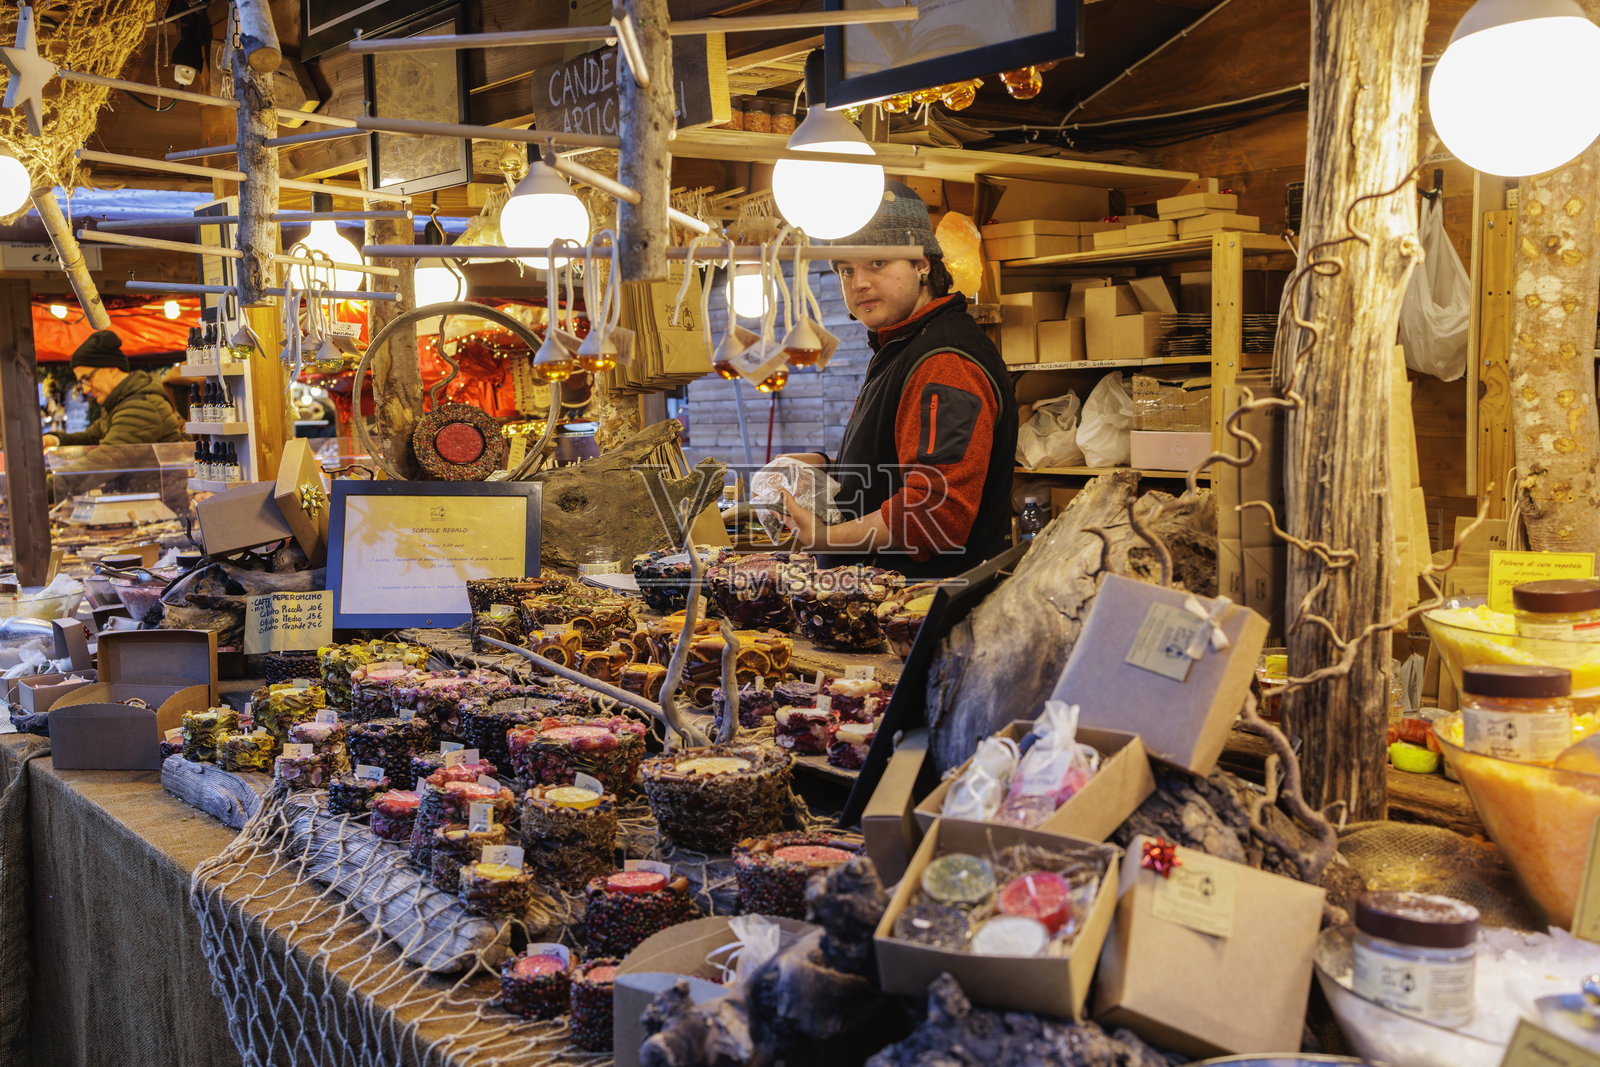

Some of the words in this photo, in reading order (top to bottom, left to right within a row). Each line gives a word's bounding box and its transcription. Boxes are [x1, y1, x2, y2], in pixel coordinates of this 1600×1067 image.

[549, 52, 616, 106] CANDE
[272, 593, 322, 601] PEPERONCINO
[281, 604, 303, 614] Piccolo
[282, 614, 302, 623] Medio
[281, 622, 306, 631] Grande
